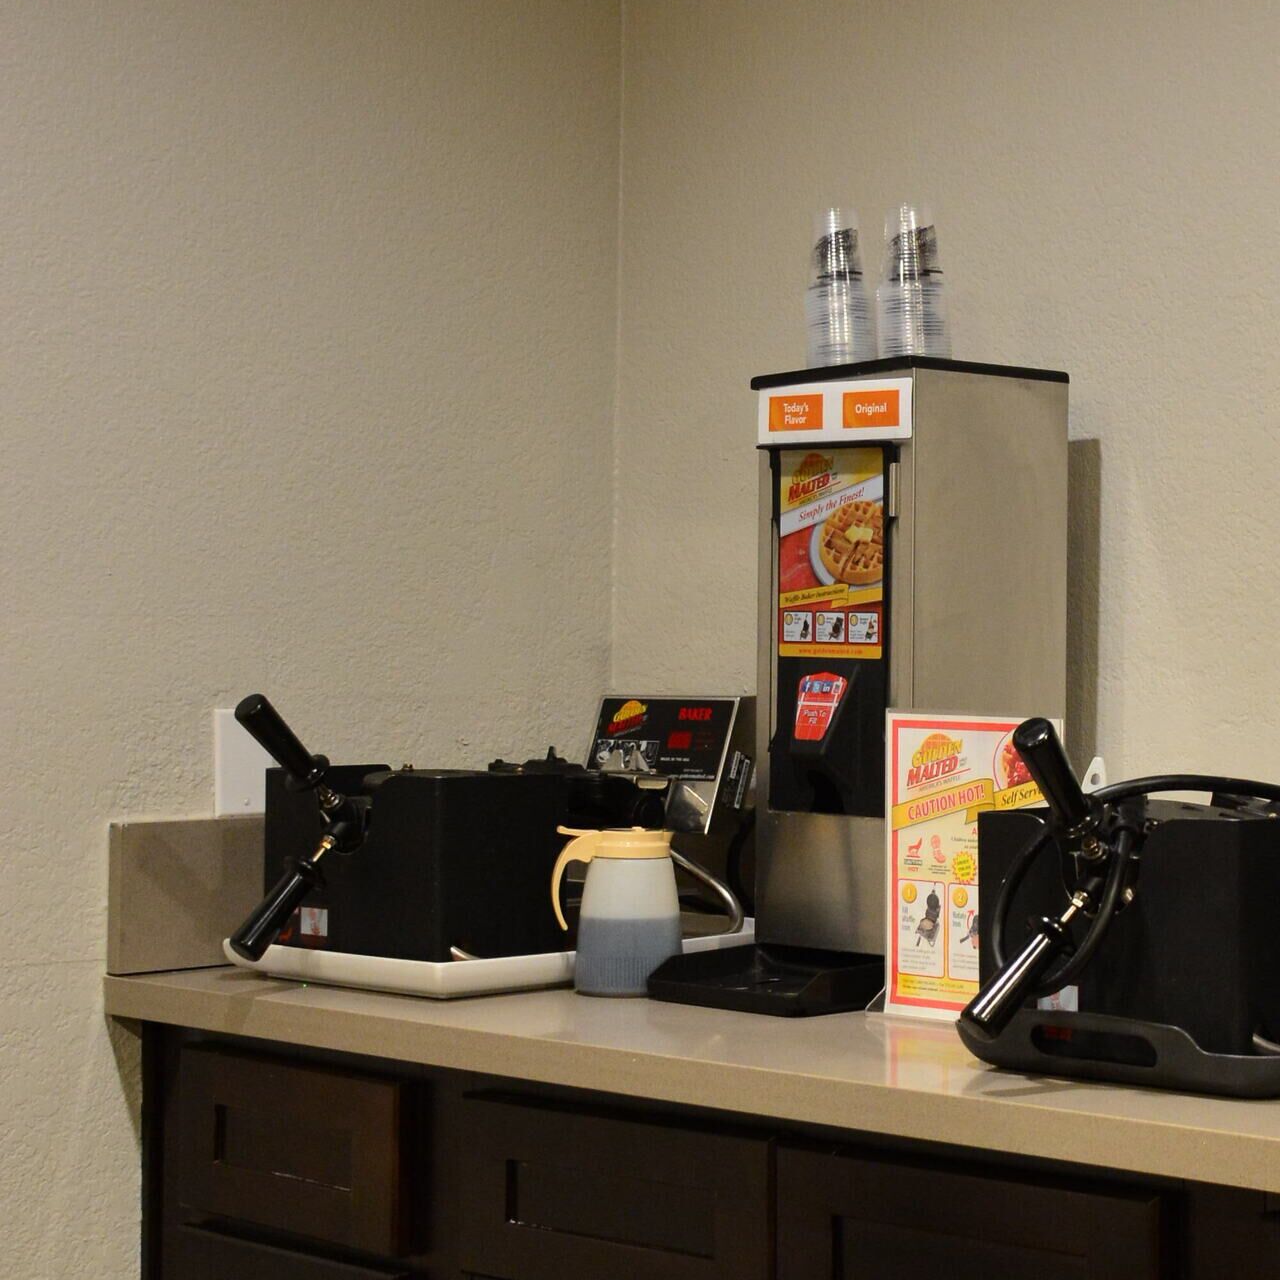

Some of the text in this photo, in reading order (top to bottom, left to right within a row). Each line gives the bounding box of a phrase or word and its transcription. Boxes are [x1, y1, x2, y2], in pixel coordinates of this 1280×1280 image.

[783, 402, 809, 416] Today's
[855, 402, 888, 416] Original
[784, 414, 808, 425] Flavor
[788, 473, 831, 502] MALTED
[799, 504, 825, 521] Simply
[825, 499, 838, 510] the
[678, 707, 713, 721] BAKER
[911, 738, 963, 768] GOLDEN
[906, 754, 959, 787] MALTED
[908, 783, 985, 821] CAUTION HOT!
[1001, 790, 1018, 807] Self
